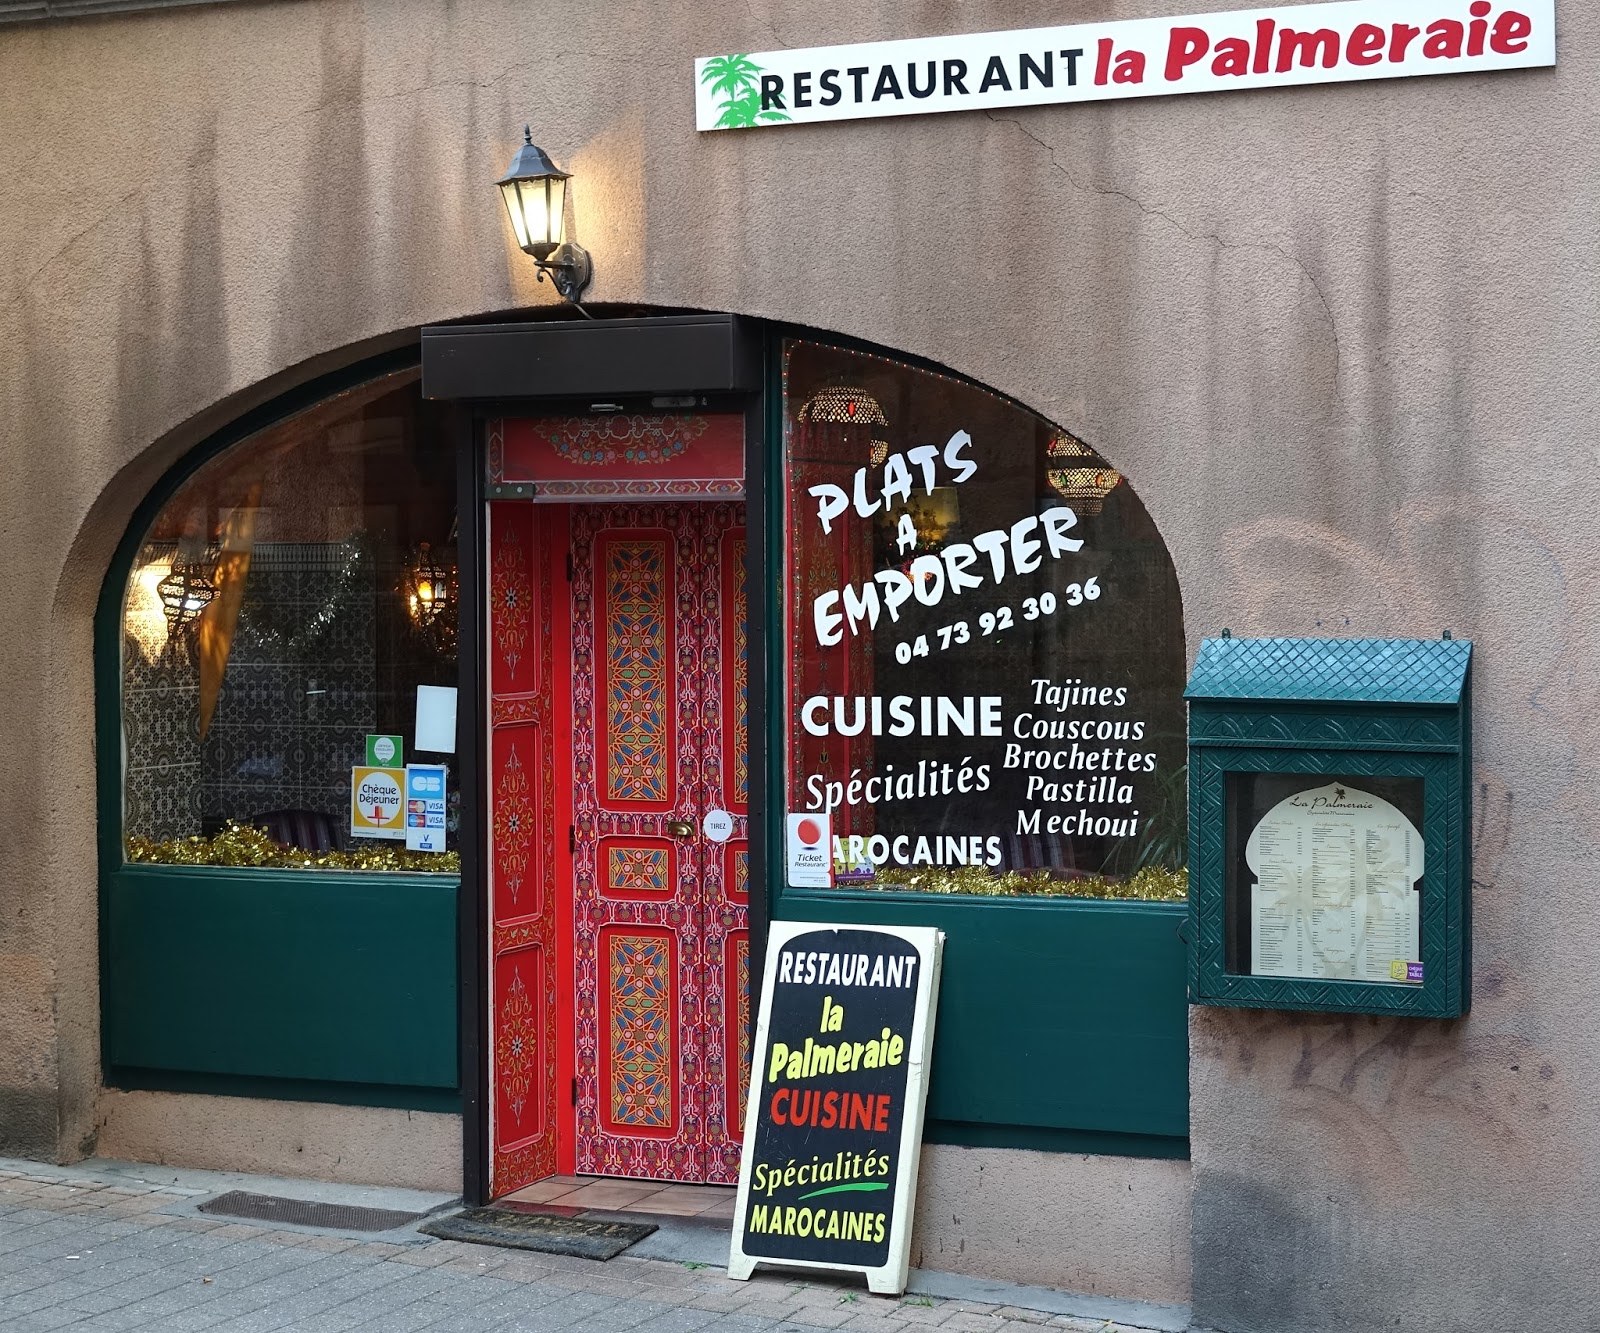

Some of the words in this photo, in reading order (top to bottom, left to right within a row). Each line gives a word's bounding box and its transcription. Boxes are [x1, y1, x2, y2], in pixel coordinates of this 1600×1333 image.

[759, 48, 1085, 111] RESTAURANT
[1094, 38, 1144, 85] la
[1163, 1, 1531, 81] Palmeraie
[807, 429, 979, 536] PLATS
[896, 513, 918, 556] A
[813, 506, 1085, 646] EMPORTER
[895, 634, 930, 665] 04
[937, 621, 971, 650] 73
[978, 606, 1014, 637] 92
[1022, 591, 1057, 621] 30
[1065, 576, 1101, 607] 36
[1030, 678, 1128, 712] Tajines
[801, 695, 1003, 737] CUISINE
[1013, 712, 1145, 741] Couscous
[1002, 743, 1157, 773] Brochettes
[359, 793, 400, 805] Déjeuner
[362, 783, 397, 796] Chèque
[805, 756, 991, 814] Spécialités
[1026, 775, 1134, 804] Pastilla
[1289, 796, 1309, 807] La
[1311, 794, 1374, 810] Palmeraie
[429, 802, 444, 810] VISA
[429, 816, 444, 824] VISA
[1016, 809, 1139, 838] Mechoui
[710, 822, 727, 830] TIREZ
[797, 853, 823, 862] Ticket
[832, 834, 1003, 867] AROCAINES
[779, 951, 917, 988] RESTAURANT
[819, 995, 844, 1033] la
[768, 1027, 904, 1083] Palmeraie
[770, 1087, 891, 1132] CUISINE
[752, 1149, 890, 1197] Spécialités
[749, 1204, 886, 1244] MAROCAINES
